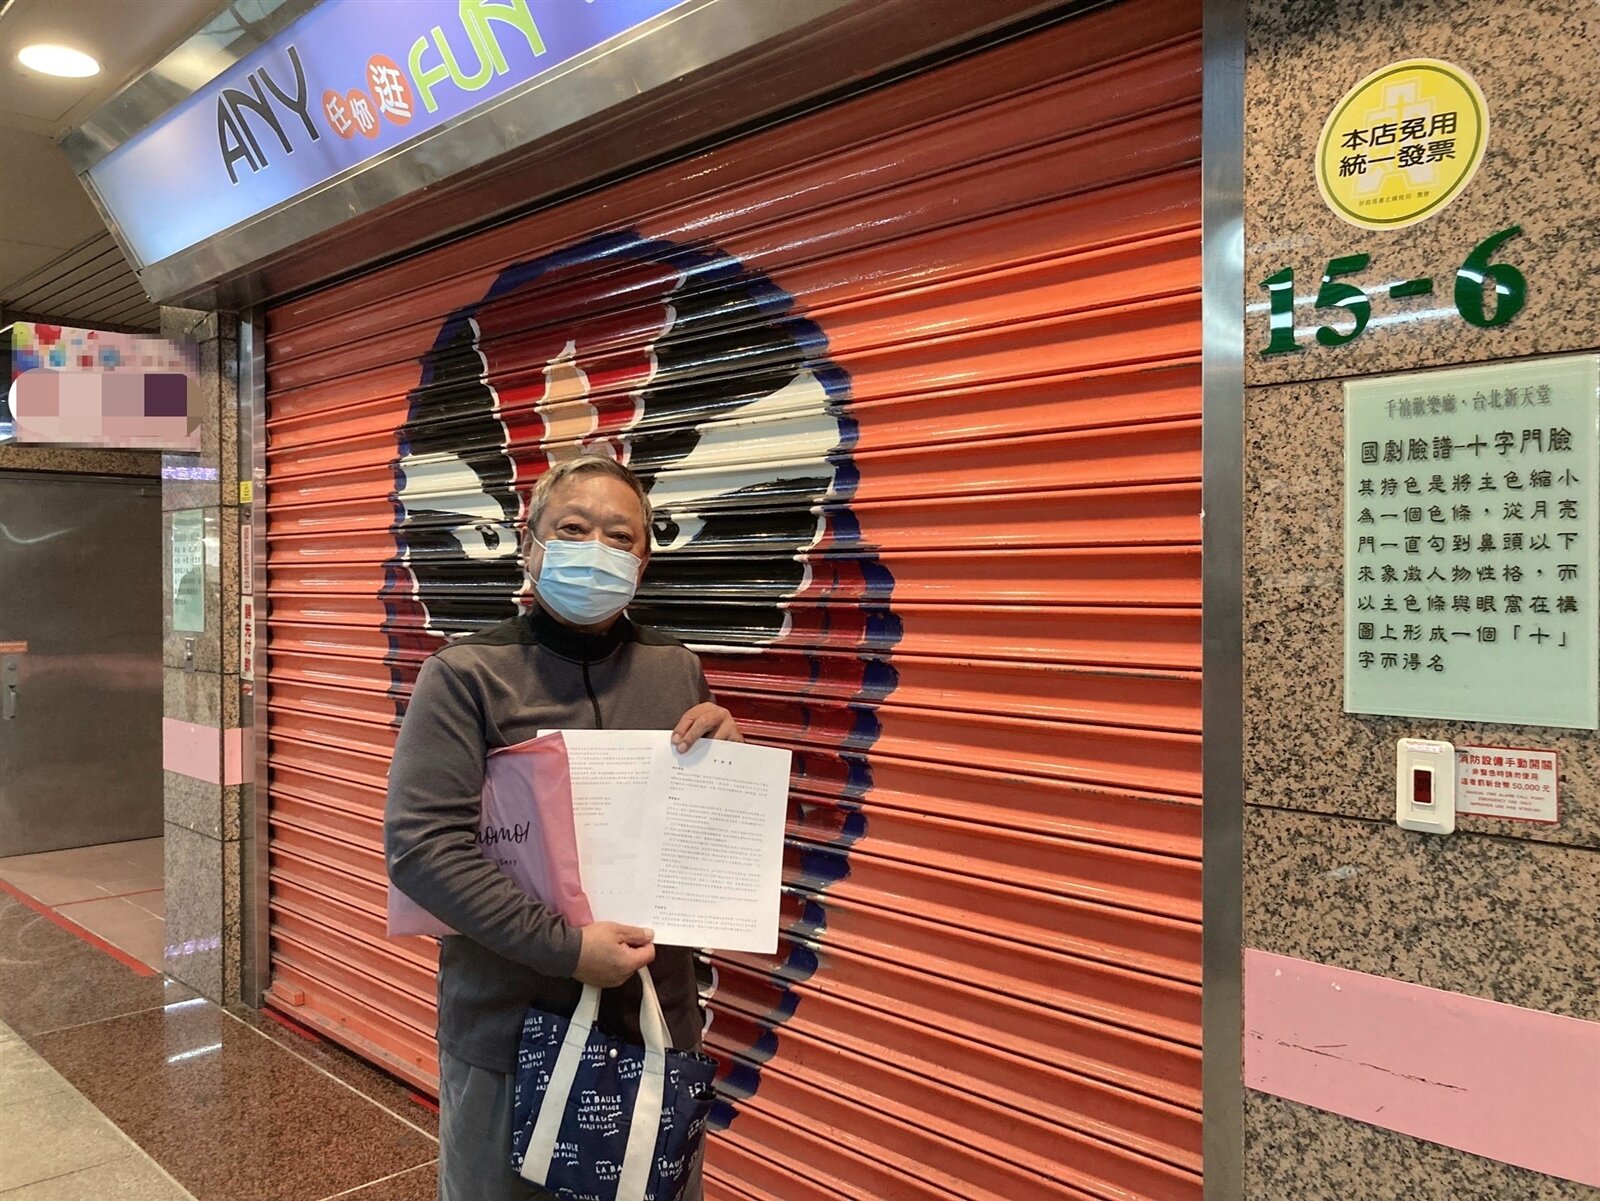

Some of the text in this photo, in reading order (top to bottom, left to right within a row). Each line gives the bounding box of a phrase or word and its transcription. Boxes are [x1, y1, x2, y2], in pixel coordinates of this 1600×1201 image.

[216, 0, 546, 186] ANY 任你逛 FUN
[1341, 112, 1457, 150] 本店免用
[1339, 138, 1456, 177] 統一發票
[1259, 225, 1527, 355] 15-6
[1358, 468, 1579, 496] 其特色是將主色縮小
[1358, 532, 1579, 554] 門一直勾到鼻頭以下
[1358, 651, 1445, 672] 字而得名
[1458, 754, 1553, 770] 消防設備手動開關
[581, 1095, 622, 1104] LA BAULE
[577, 1113, 587, 1122] LA
[596, 1165, 607, 1174] LA
